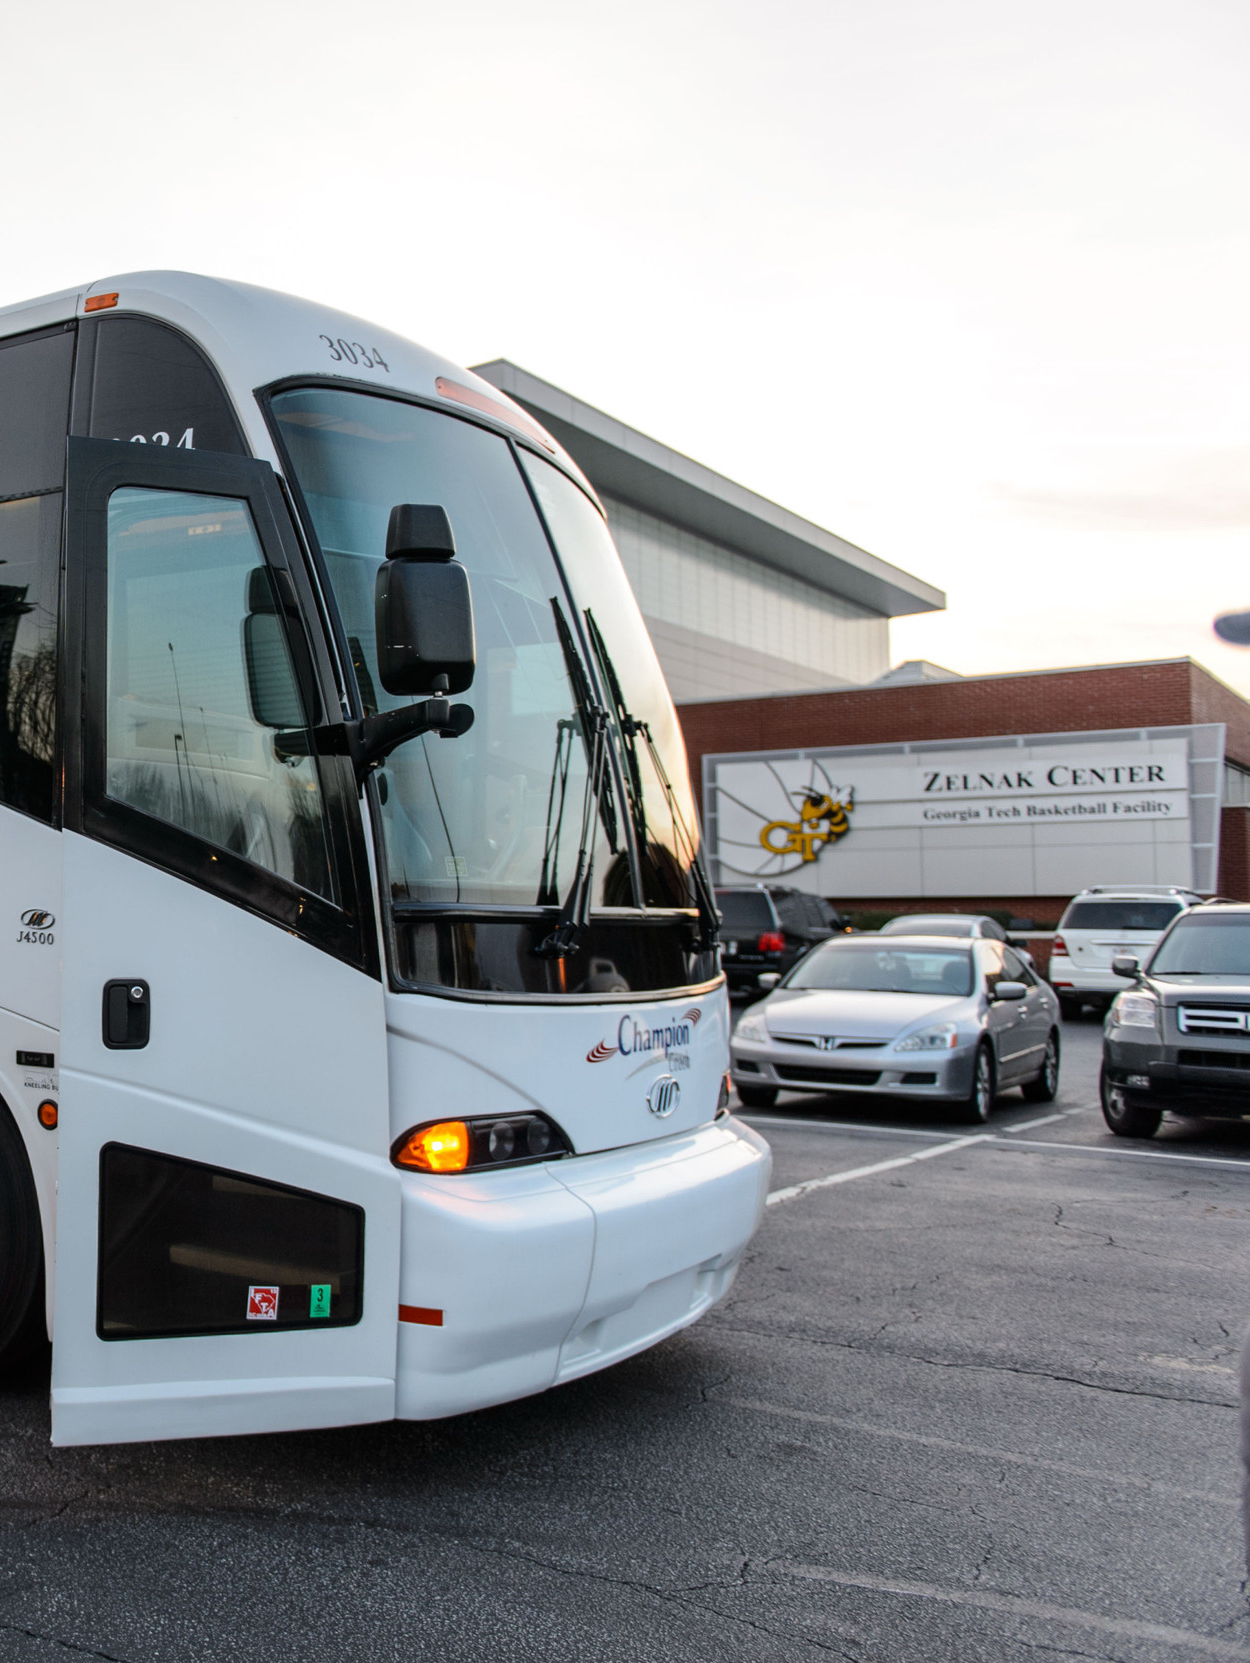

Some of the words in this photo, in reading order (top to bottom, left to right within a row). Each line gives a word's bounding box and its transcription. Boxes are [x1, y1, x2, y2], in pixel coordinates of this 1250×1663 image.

[319, 334, 390, 373] 3034
[923, 771, 1034, 792] ZELNAK
[1046, 765, 1166, 787] CENTER
[923, 807, 981, 823] Georgia
[986, 804, 1021, 819] Tech
[1026, 801, 1107, 818] Basketball
[1112, 799, 1173, 816] Facility
[16, 931, 54, 945] J4500
[618, 1014, 690, 1058] Champion
[24, 1082, 50, 1090] KNEELING
[317, 1288, 324, 1302] 3
